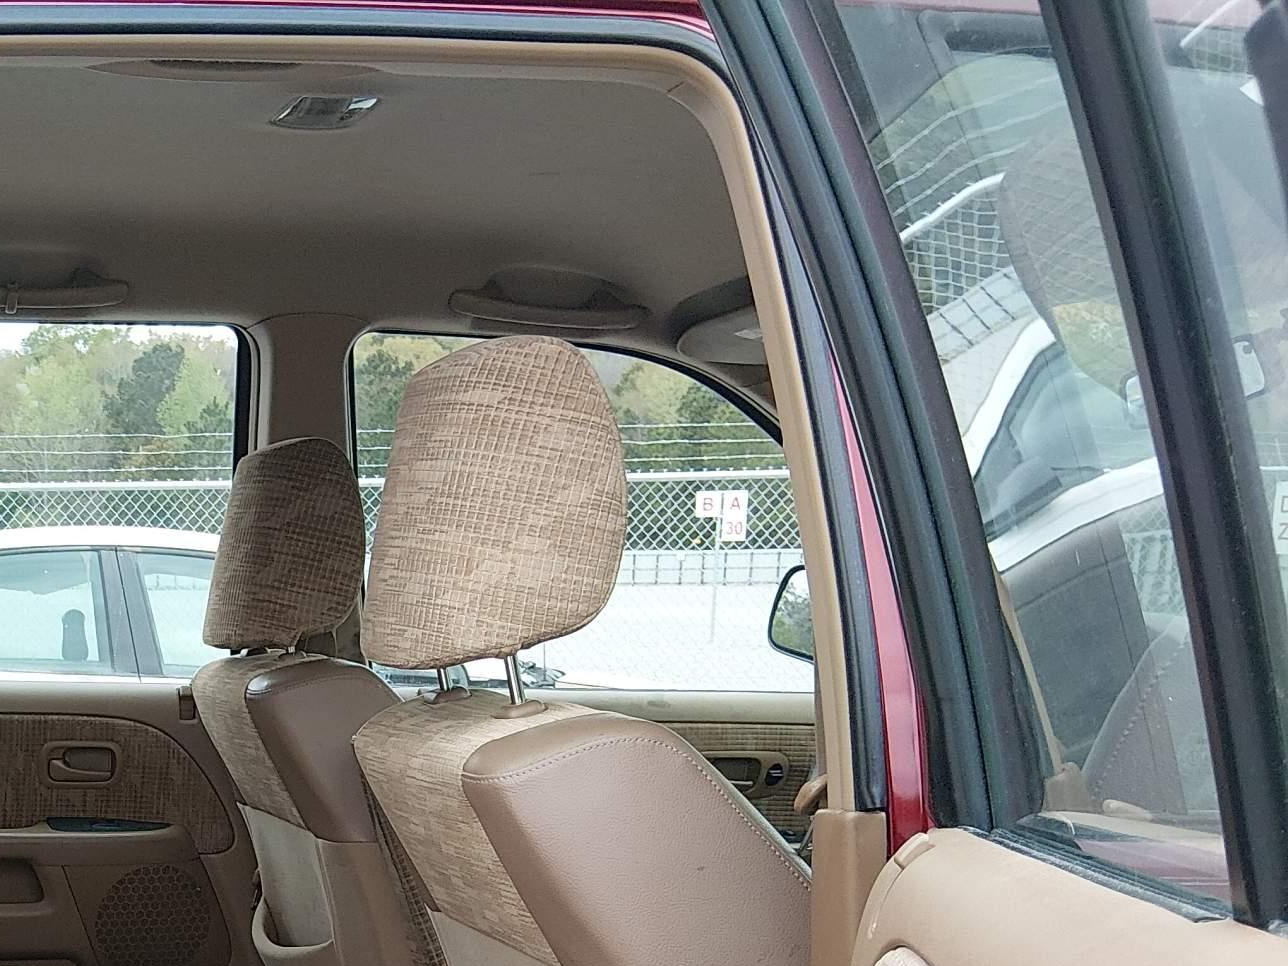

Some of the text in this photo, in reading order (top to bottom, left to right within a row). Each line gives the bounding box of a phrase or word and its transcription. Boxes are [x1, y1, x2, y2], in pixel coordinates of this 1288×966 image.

[702, 497, 741, 511] B A
[726, 521, 743, 535] 30
